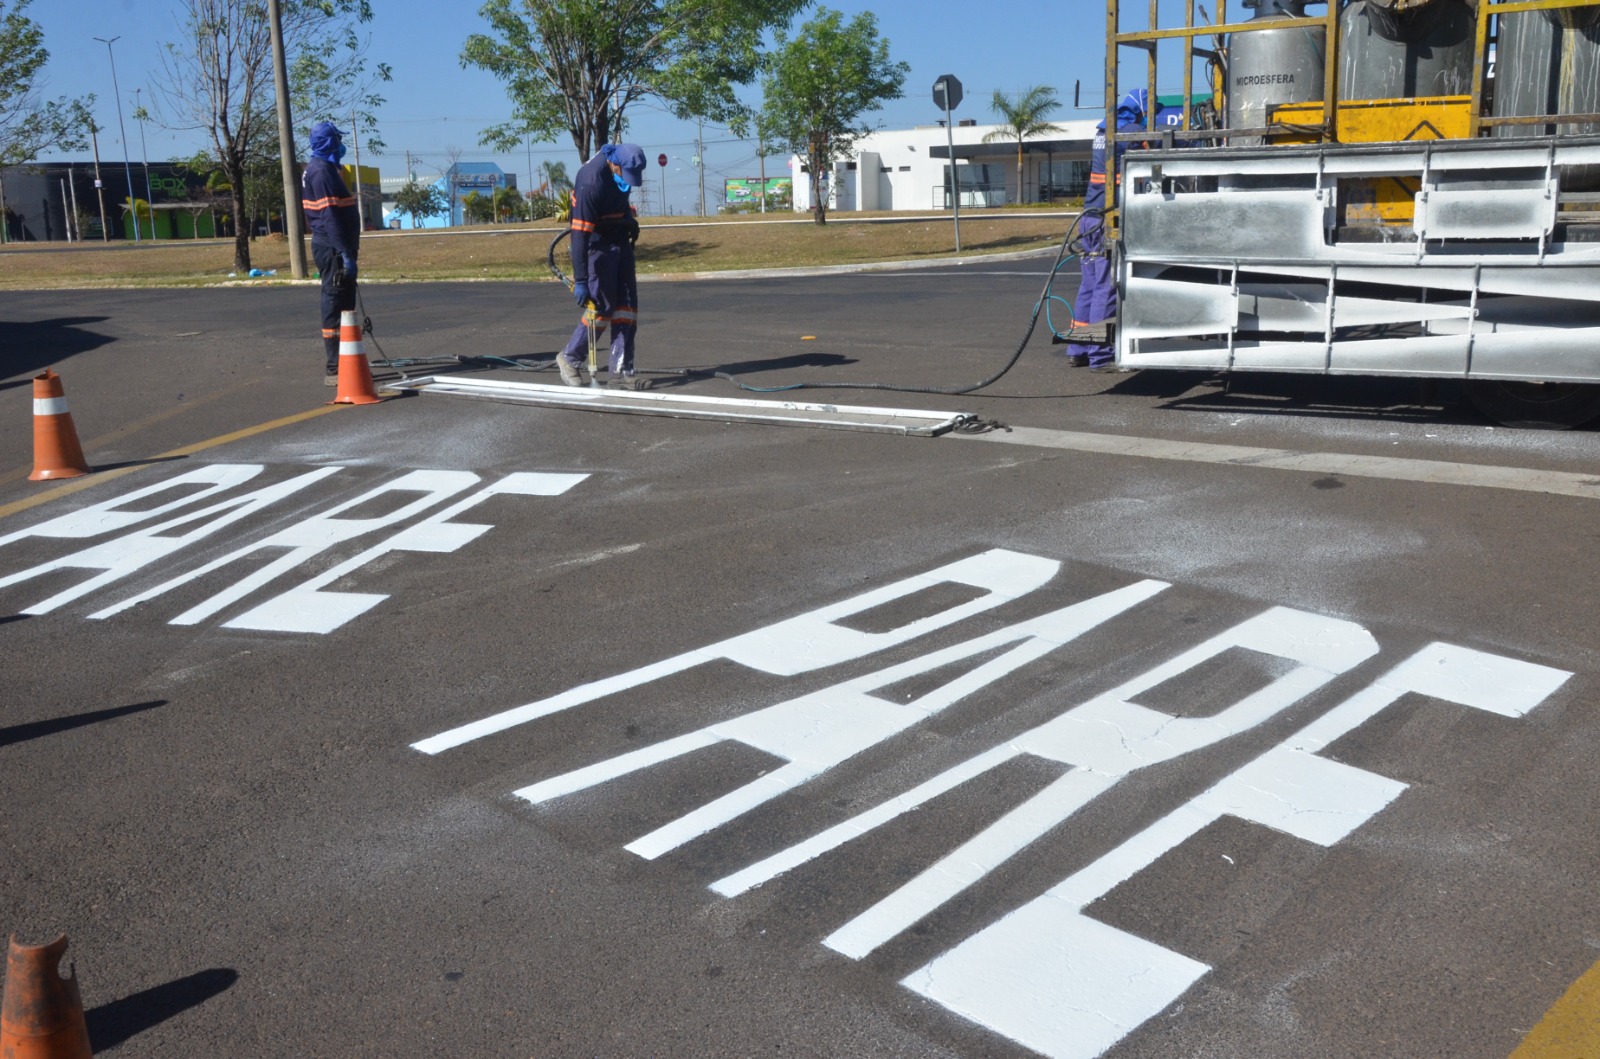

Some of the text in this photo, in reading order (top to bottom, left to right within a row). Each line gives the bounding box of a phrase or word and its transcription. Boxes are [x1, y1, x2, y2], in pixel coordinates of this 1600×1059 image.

[1236, 74, 1295, 87] MICROESFERA
[149, 178, 187, 190] BOX
[0, 463, 591, 635] PARE
[409, 548, 1574, 1059] PARE
